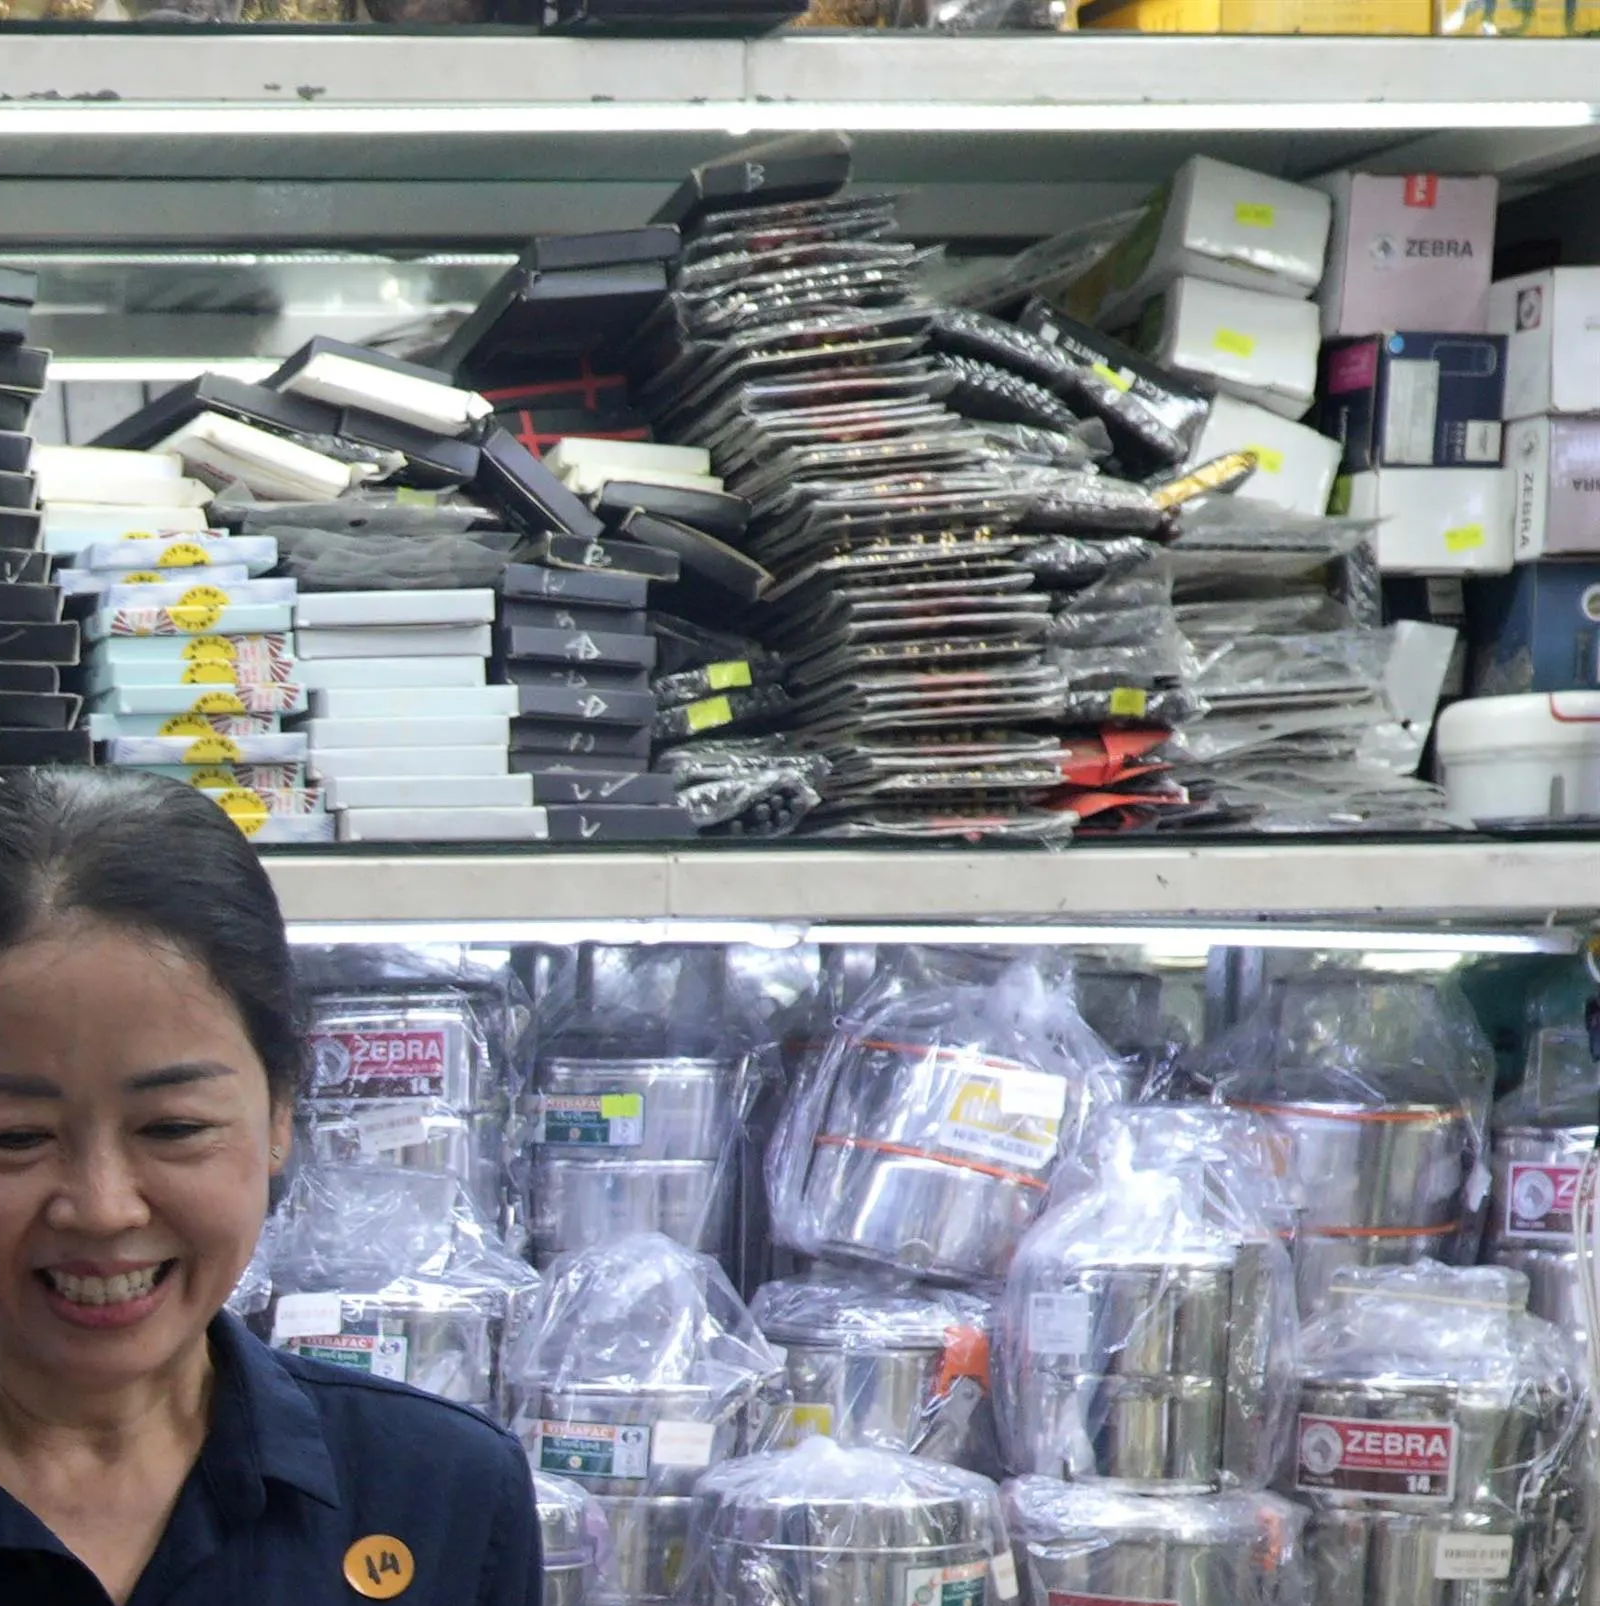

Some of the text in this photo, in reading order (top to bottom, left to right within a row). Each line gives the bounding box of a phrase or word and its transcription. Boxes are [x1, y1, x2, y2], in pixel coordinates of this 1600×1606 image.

[1405, 238, 1474, 258] ZEBRA
[1519, 473, 1535, 548] ZEBRA
[353, 1038, 441, 1062] ZEBRA
[1347, 1429, 1448, 1457] ZEBRA
[1406, 1474, 1431, 1494] 14
